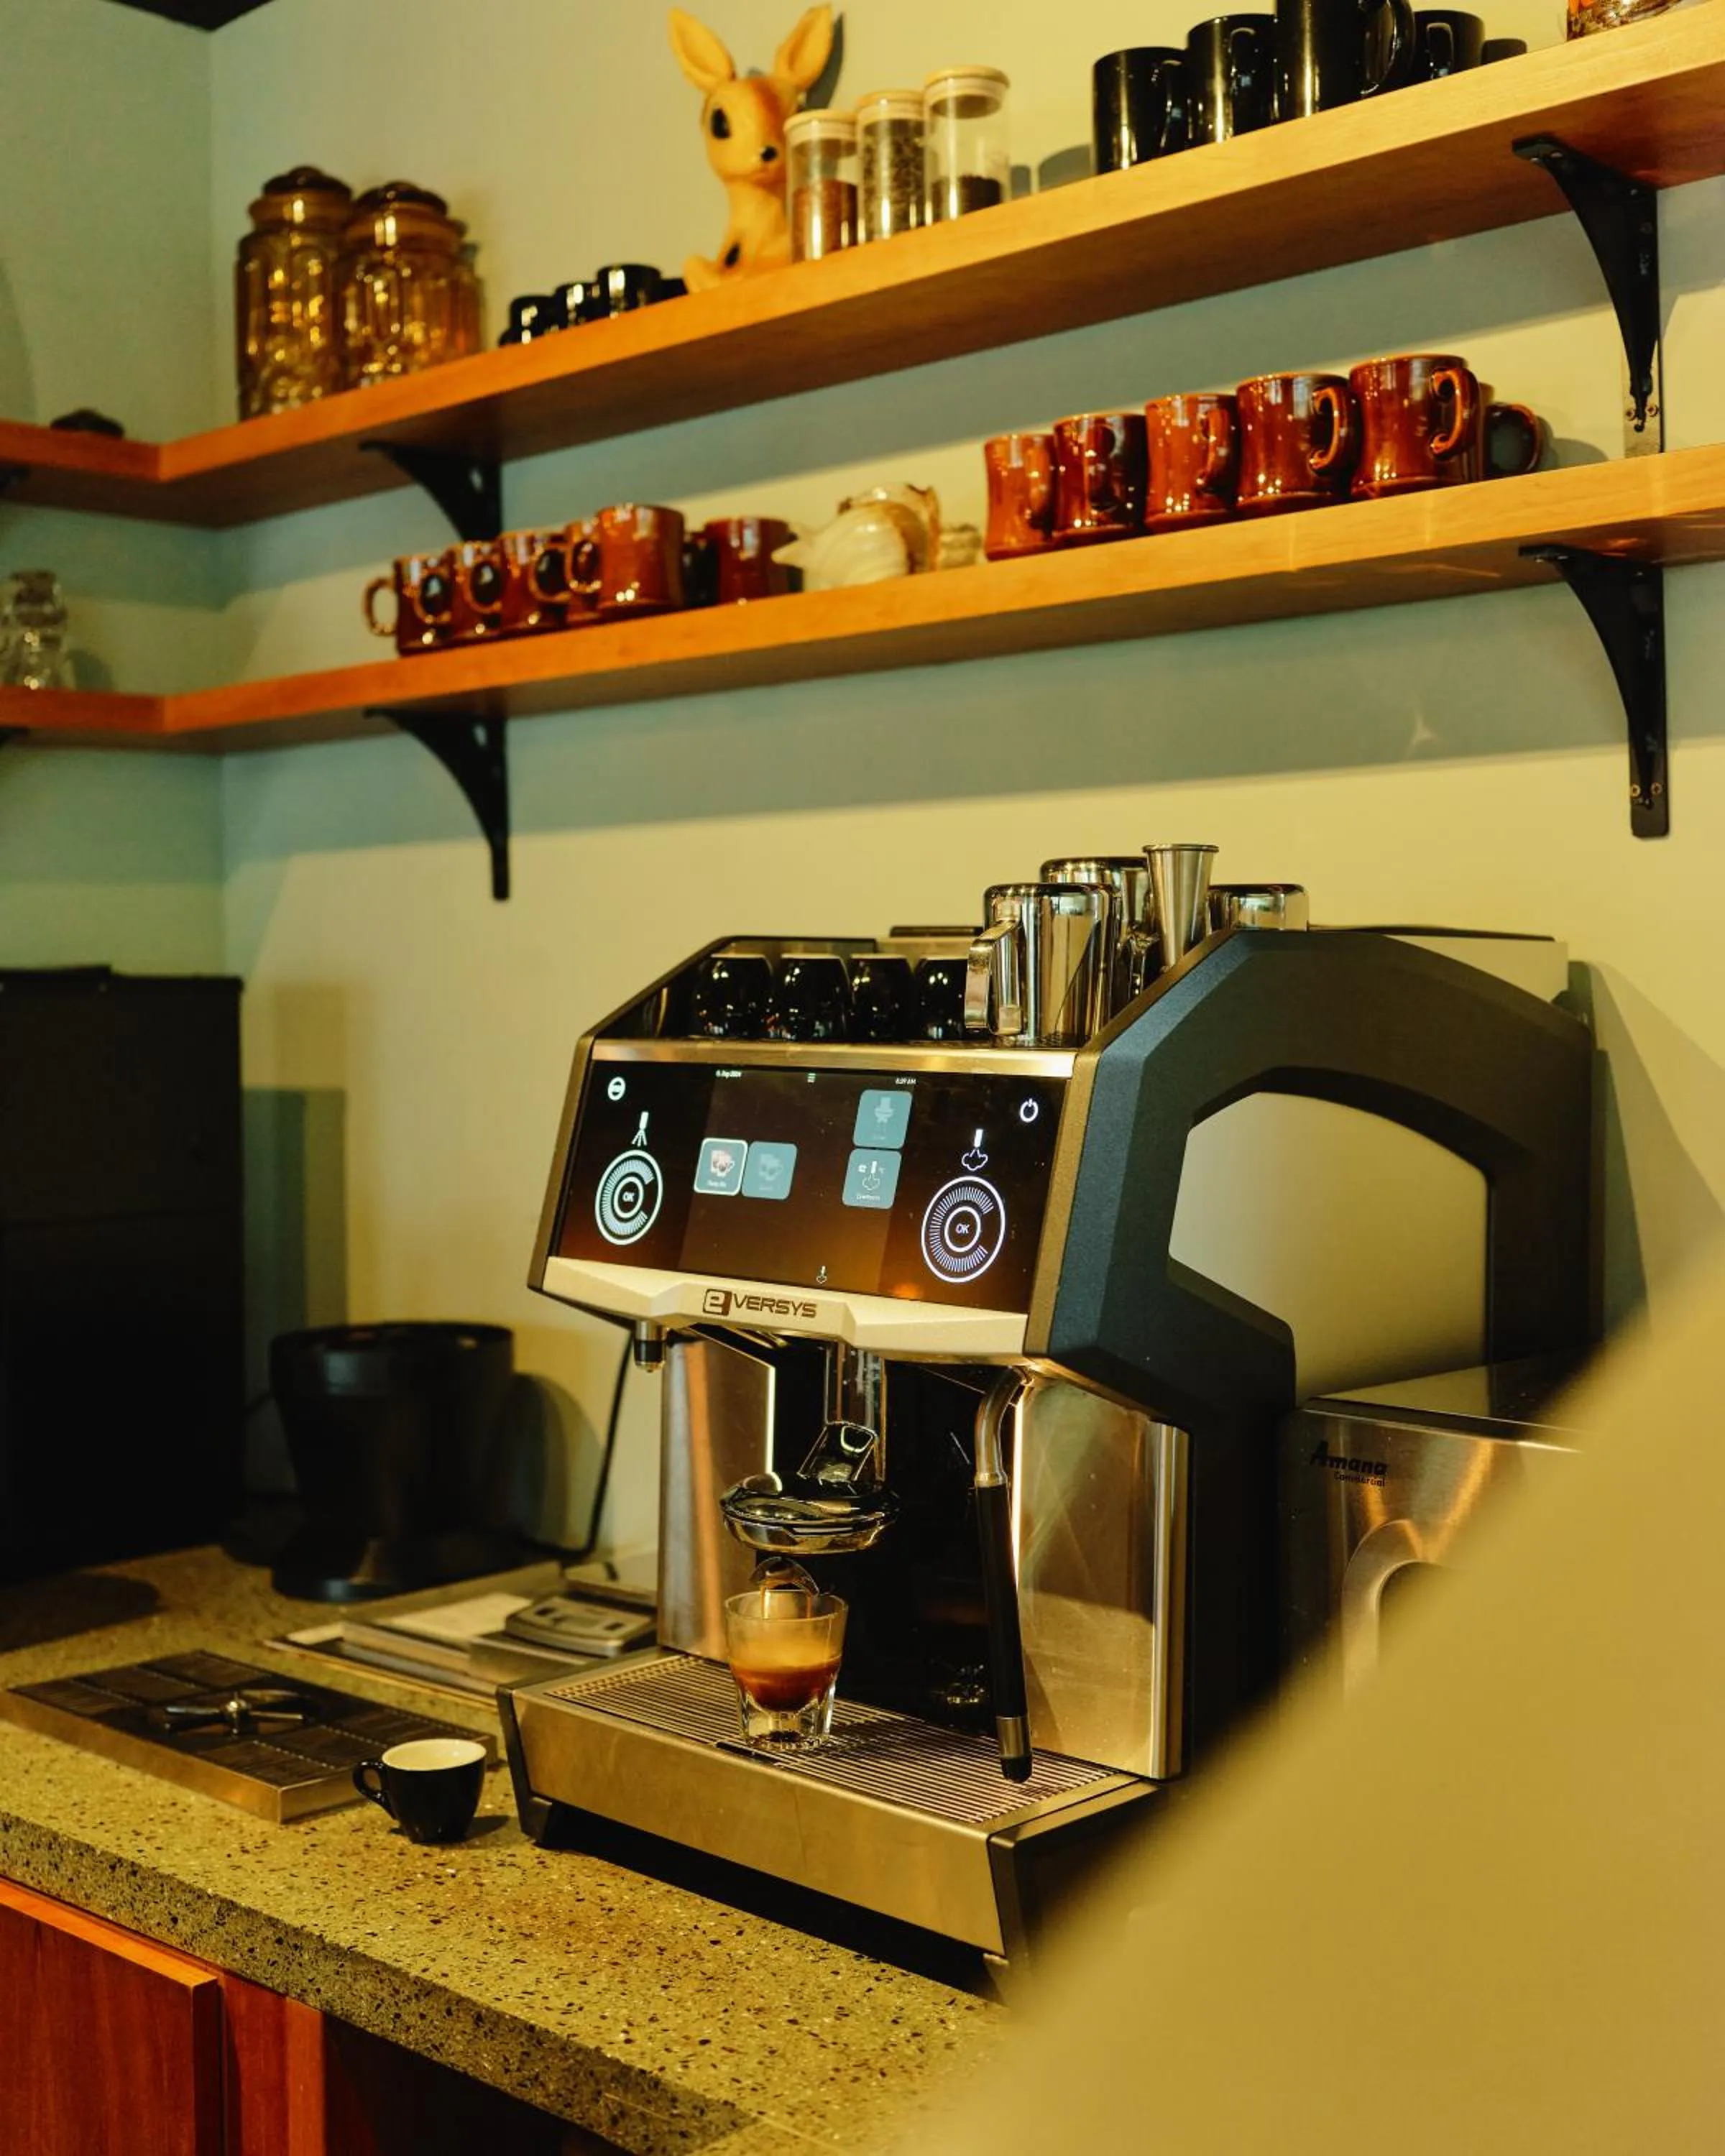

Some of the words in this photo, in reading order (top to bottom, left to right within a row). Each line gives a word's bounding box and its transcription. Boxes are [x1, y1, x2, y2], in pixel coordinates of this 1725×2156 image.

[622, 1191, 635, 1202] OK
[955, 1223, 970, 1234] OK
[1310, 1439, 1388, 1475] Amana
